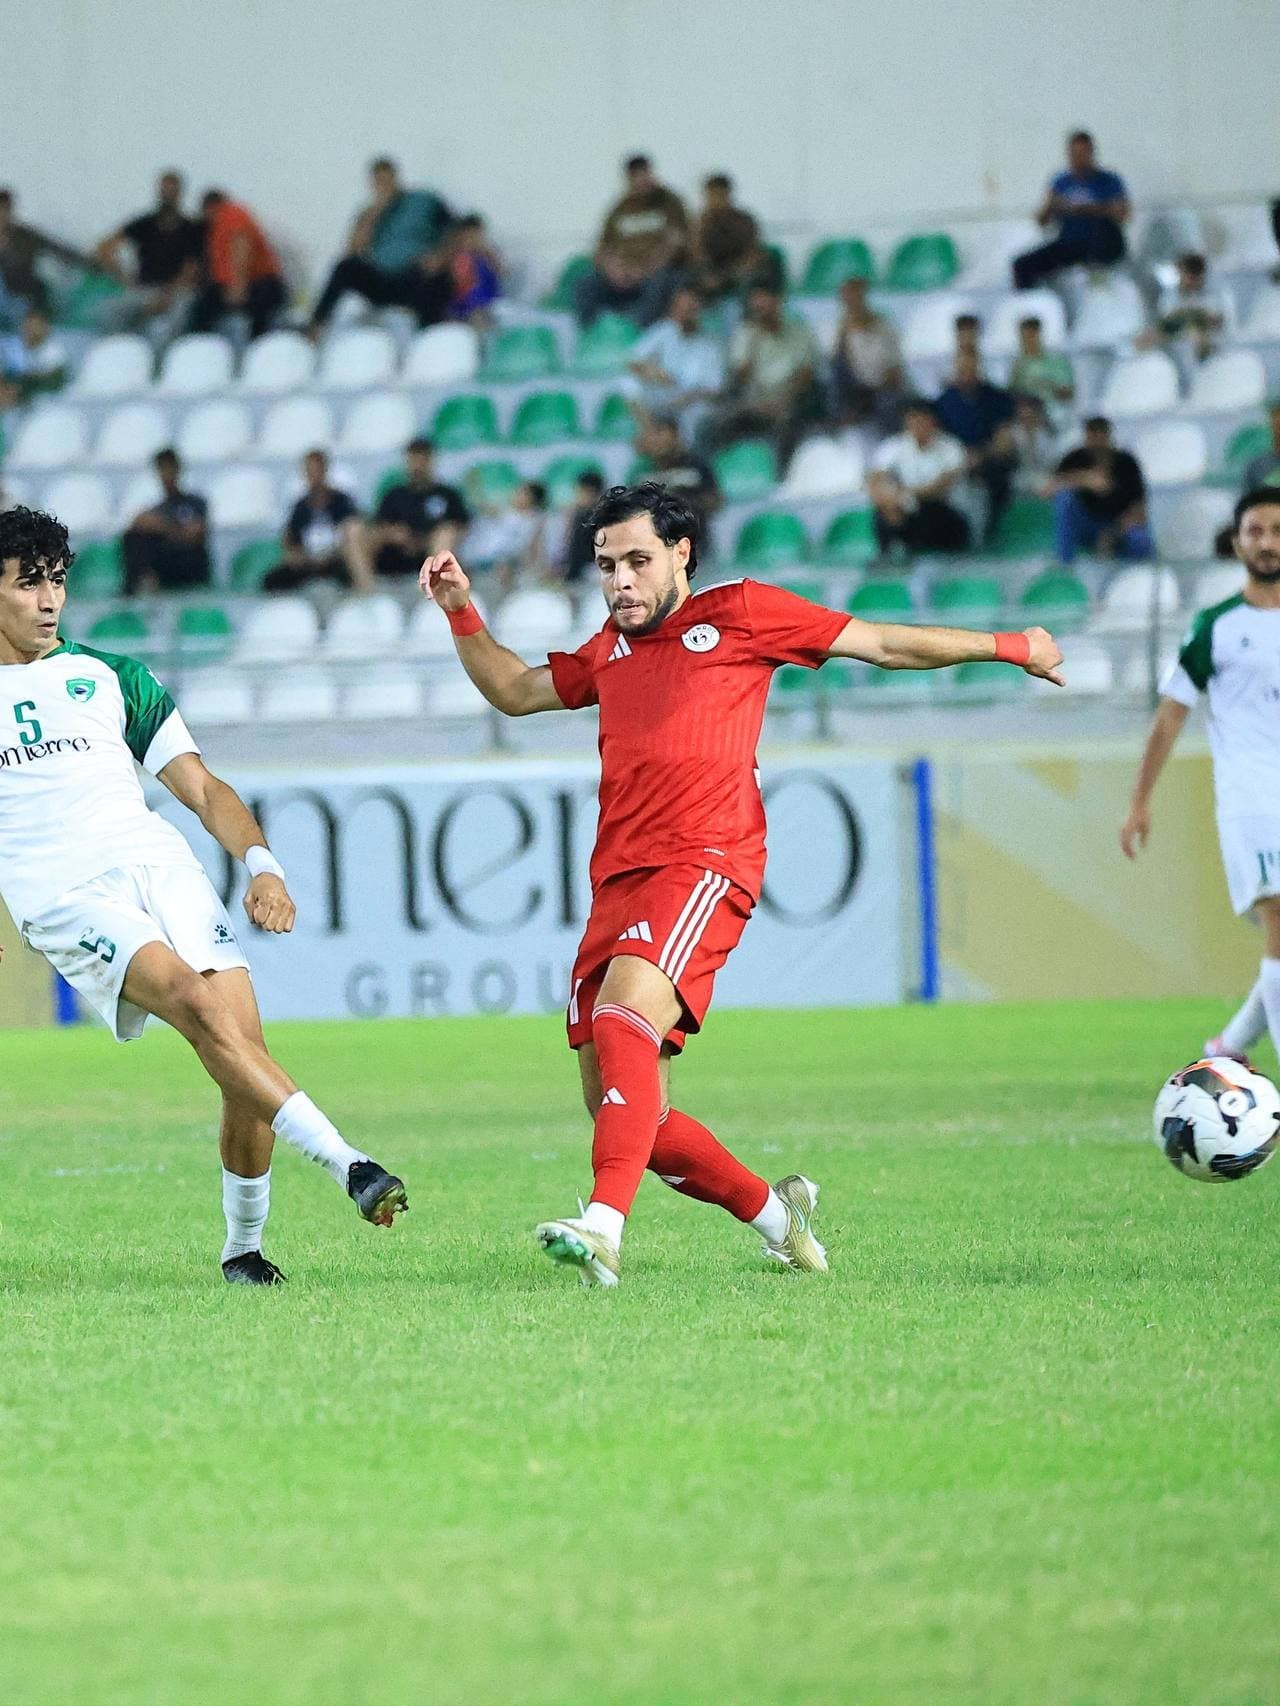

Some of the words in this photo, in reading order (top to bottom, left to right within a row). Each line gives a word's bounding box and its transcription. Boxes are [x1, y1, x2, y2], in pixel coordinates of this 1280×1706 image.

[13, 700, 42, 746] 5
[79, 926, 117, 964] 5
[344, 958, 571, 1019] GROU
